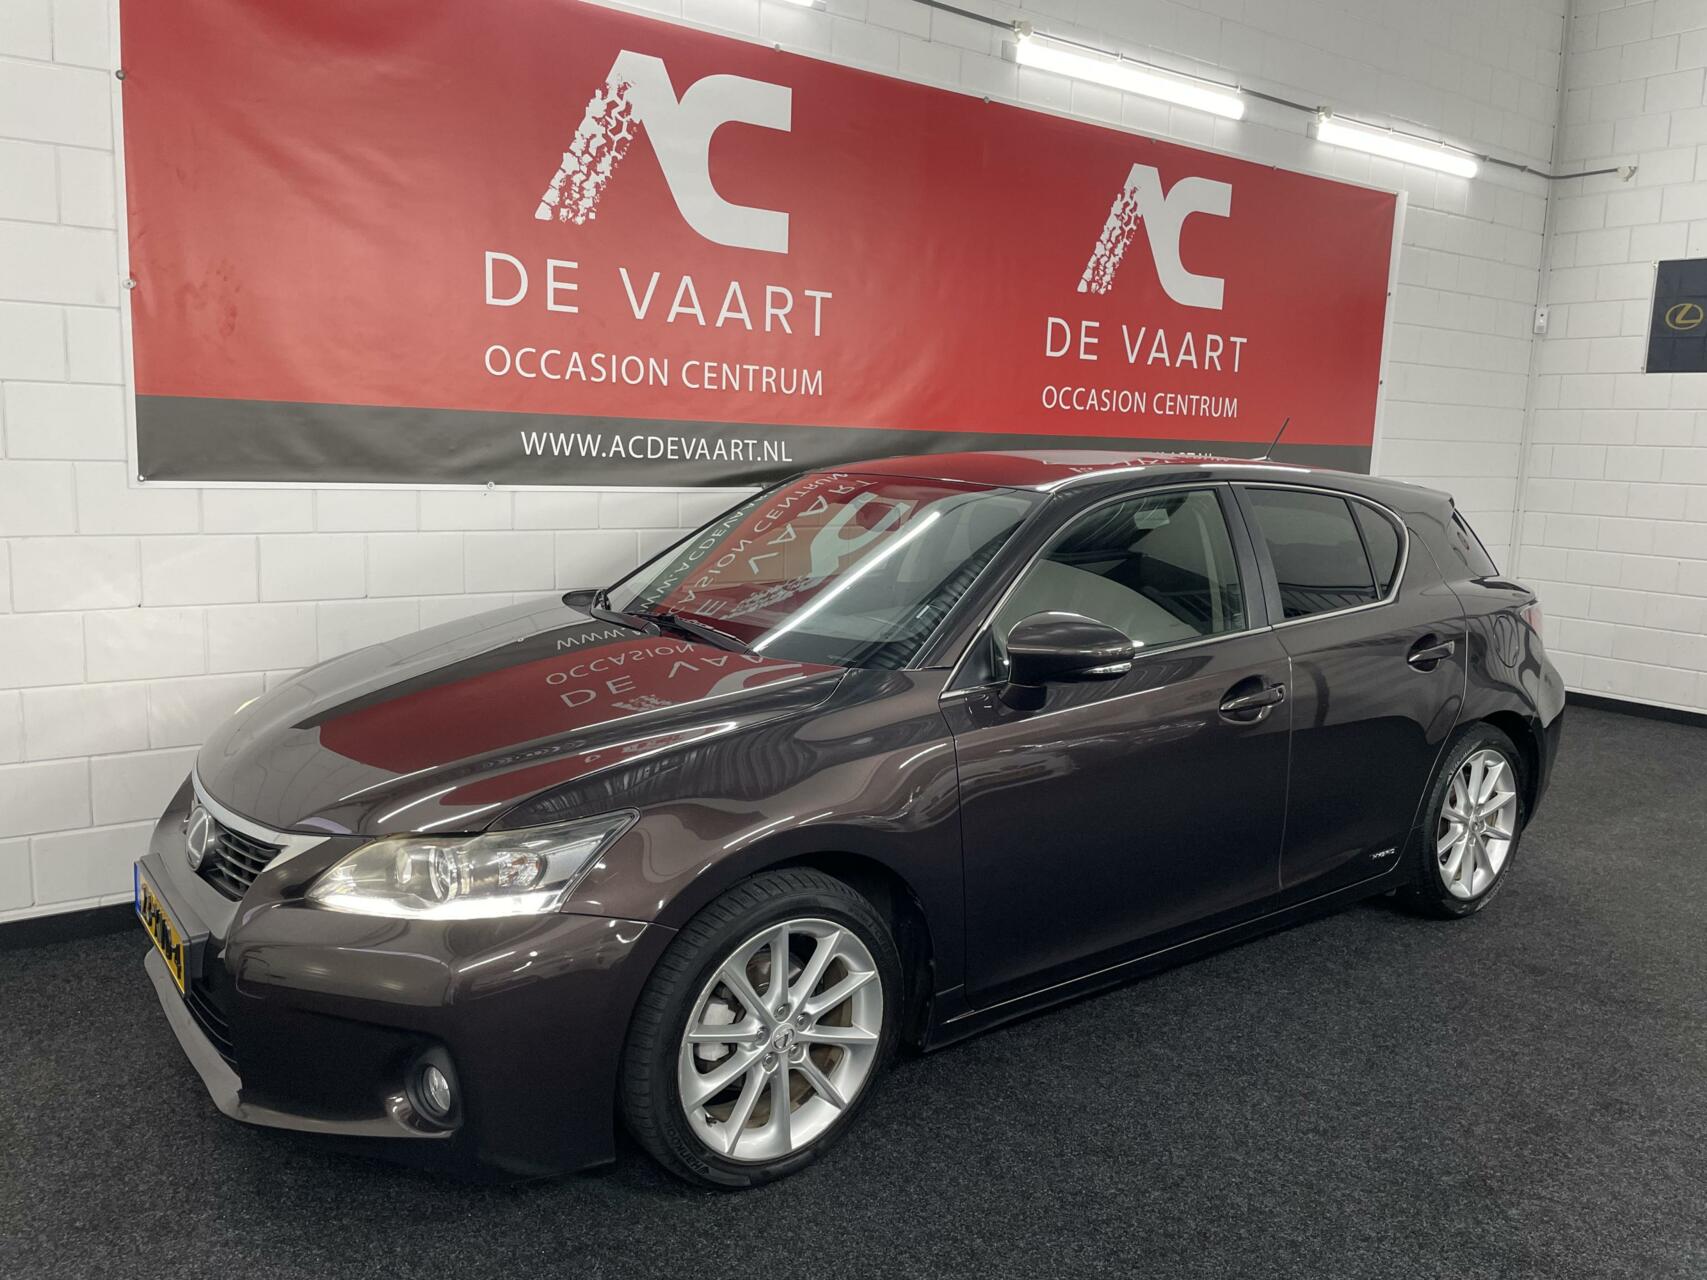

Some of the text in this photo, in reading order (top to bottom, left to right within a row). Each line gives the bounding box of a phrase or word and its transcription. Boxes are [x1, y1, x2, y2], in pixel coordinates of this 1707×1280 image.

[485, 251, 833, 337] DE VAART
[484, 344, 824, 396] OCCASION CENTRUM
[1045, 316, 1248, 373] DE VAART
[1041, 385, 1239, 418] OCCASION CENTRUM
[520, 430, 794, 462] WWW.ACDEVAART.NL
